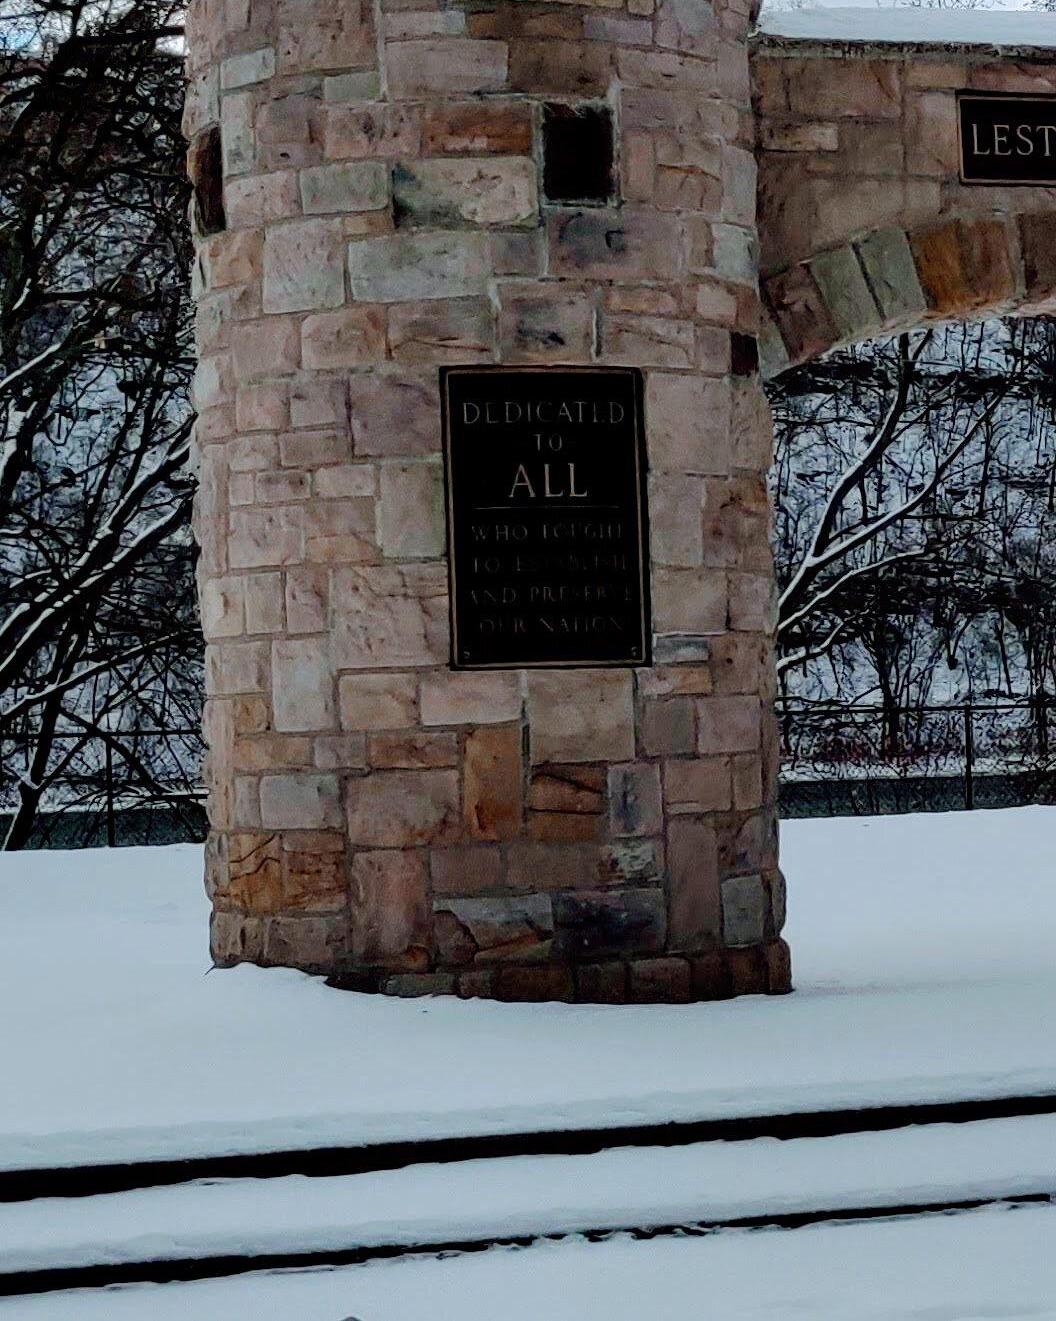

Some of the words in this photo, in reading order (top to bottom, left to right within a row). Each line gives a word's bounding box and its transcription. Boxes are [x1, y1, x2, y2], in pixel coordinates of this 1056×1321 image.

[971, 123, 1056, 157] LEST
[462, 401, 625, 424] DEDICATED
[532, 433, 564, 452] TO
[508, 462, 589, 498] ALL
[471, 523, 529, 542] WHO
[530, 585, 634, 603] PREERE
